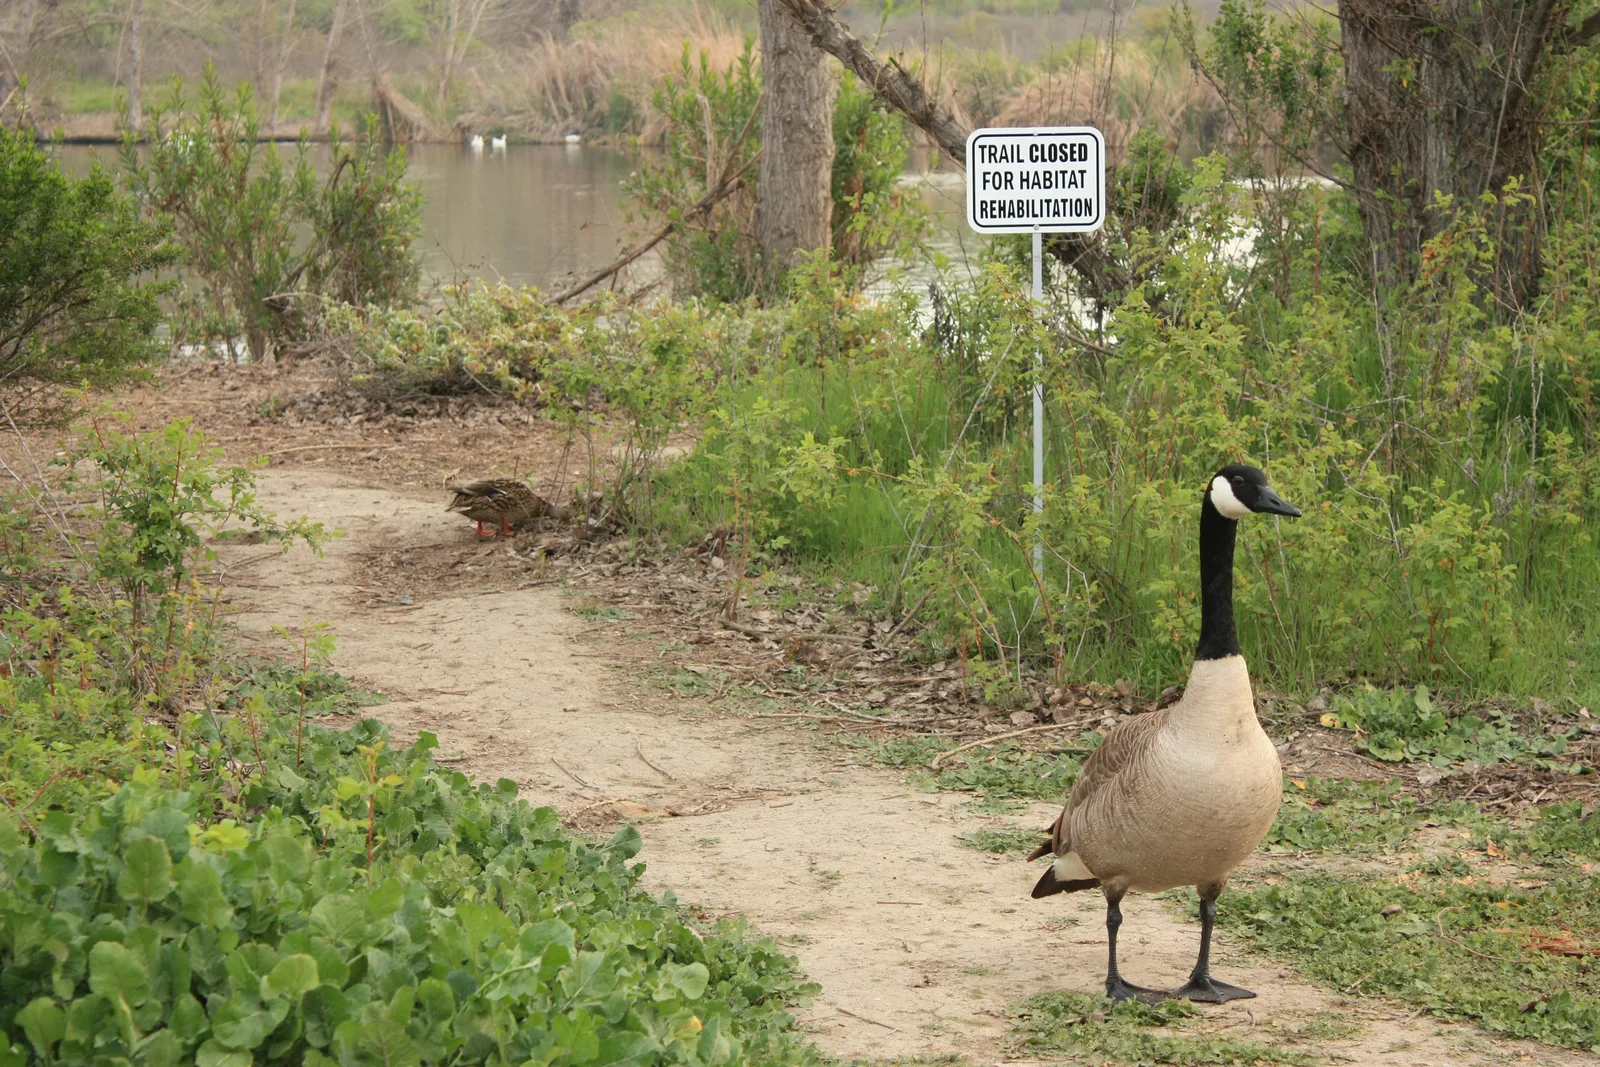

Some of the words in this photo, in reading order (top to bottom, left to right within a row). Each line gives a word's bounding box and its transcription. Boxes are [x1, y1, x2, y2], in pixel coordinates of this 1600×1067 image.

[979, 144, 1024, 163] TRAIL
[1029, 143, 1088, 163] CLOSED
[983, 171, 1014, 190] FOR
[1020, 170, 1087, 190] HABITAT
[980, 198, 1092, 219] REHABILITATION
